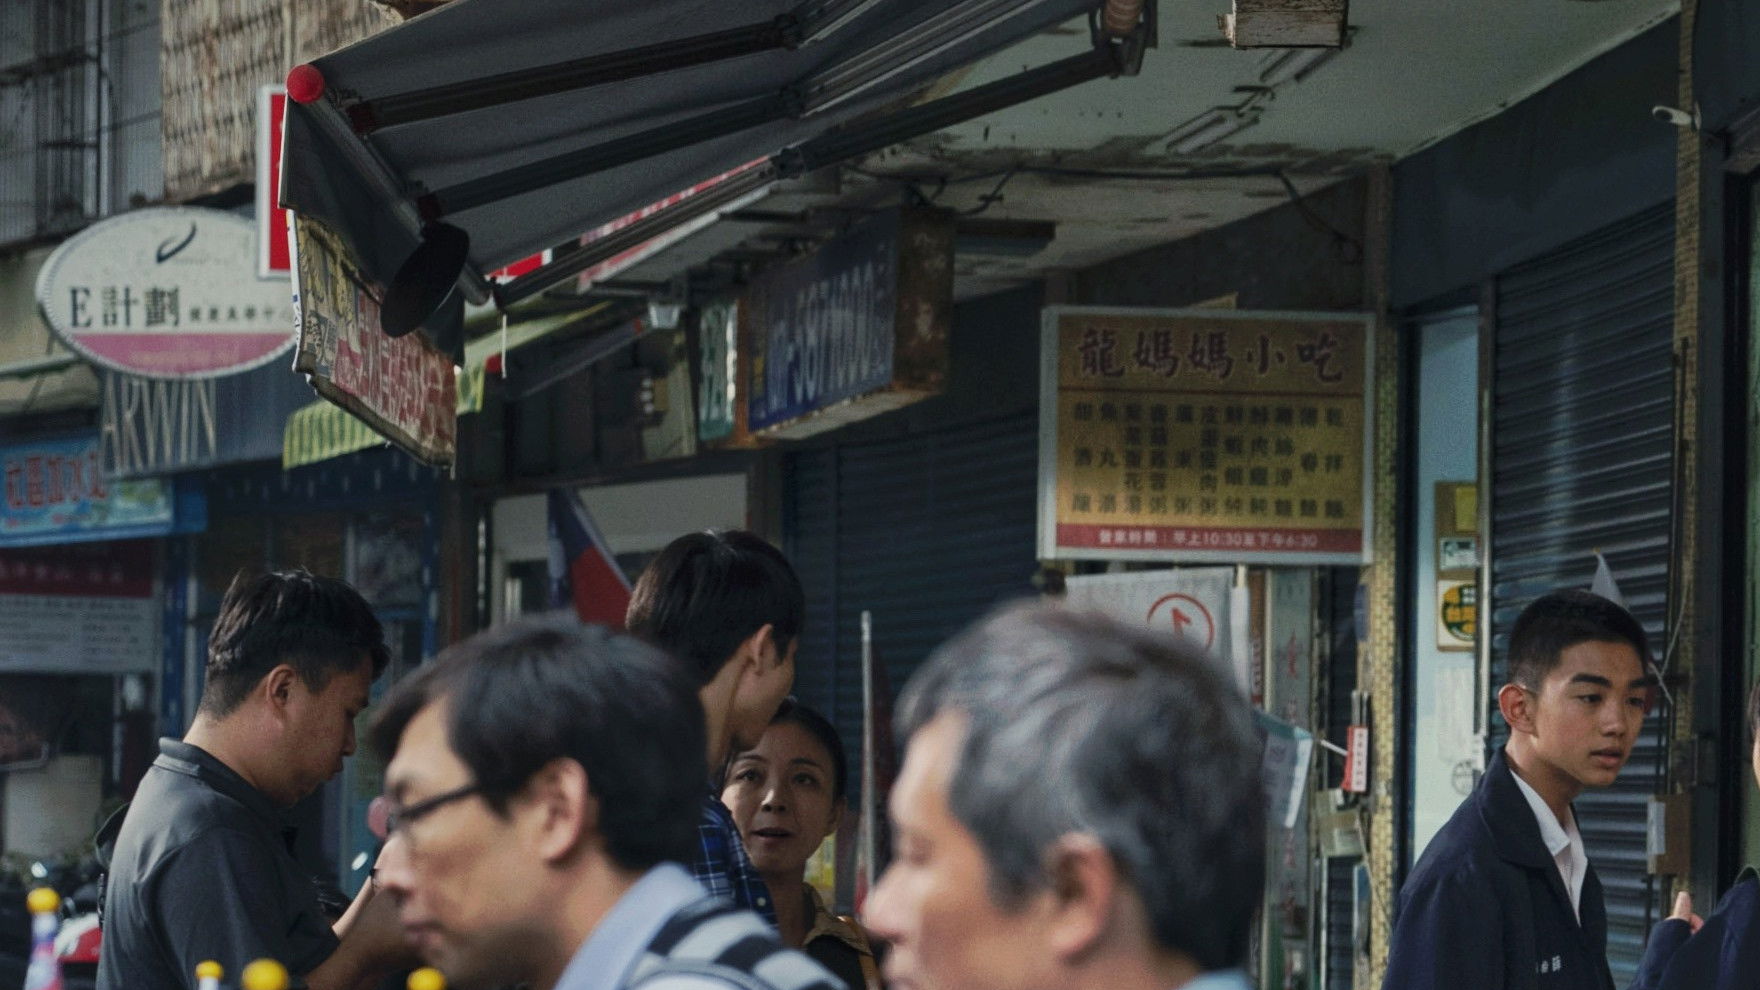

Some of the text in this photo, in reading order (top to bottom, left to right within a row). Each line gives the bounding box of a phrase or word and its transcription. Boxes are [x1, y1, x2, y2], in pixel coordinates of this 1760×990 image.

[70, 285, 181, 328] E計劃
[1079, 327, 1344, 384] 龍媽媽小吃
